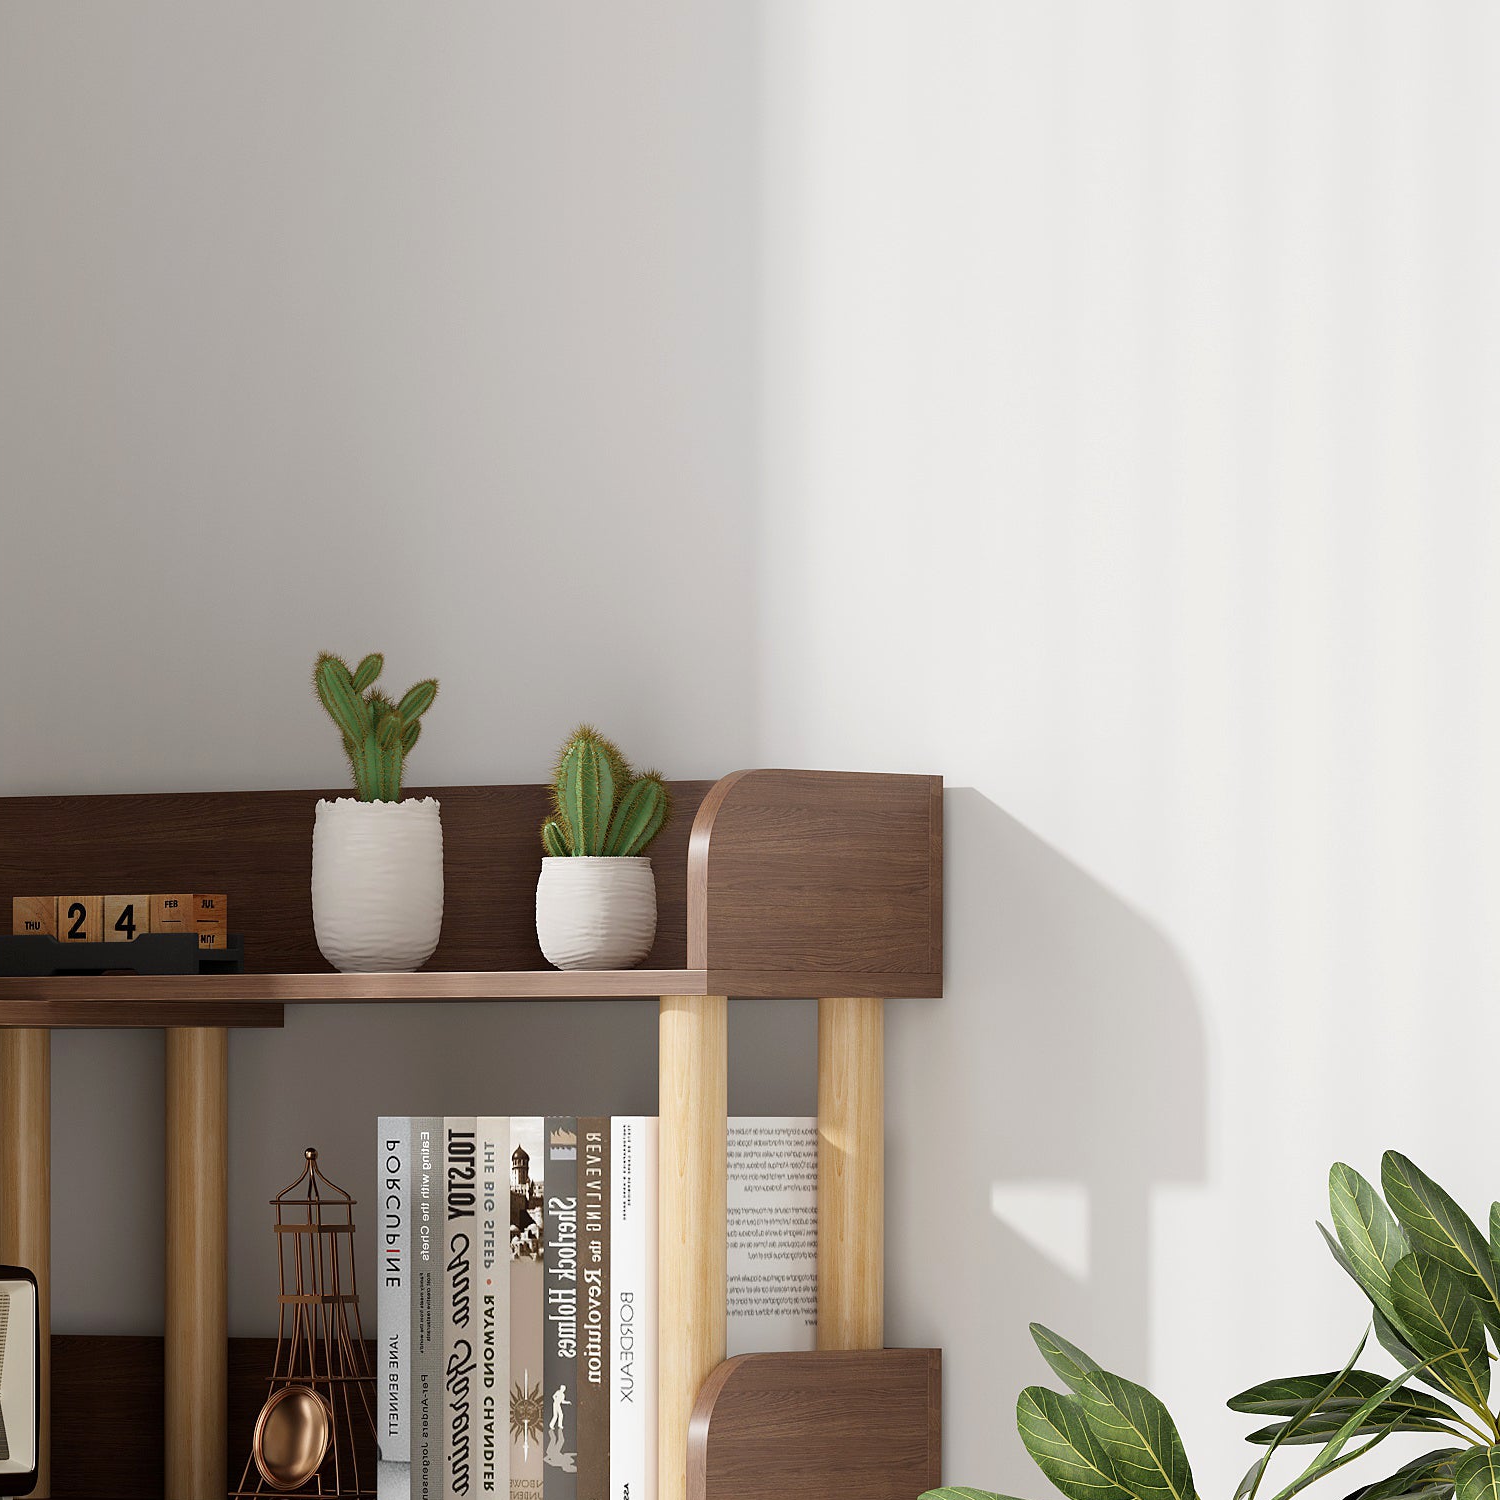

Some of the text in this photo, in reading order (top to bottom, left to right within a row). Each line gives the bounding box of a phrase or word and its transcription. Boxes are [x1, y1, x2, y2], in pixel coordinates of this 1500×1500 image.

[164, 899, 178, 908] FEB
[202, 899, 215, 909] JUL
[25, 921, 41, 930] THU
[68, 902, 136, 940] 2 4
